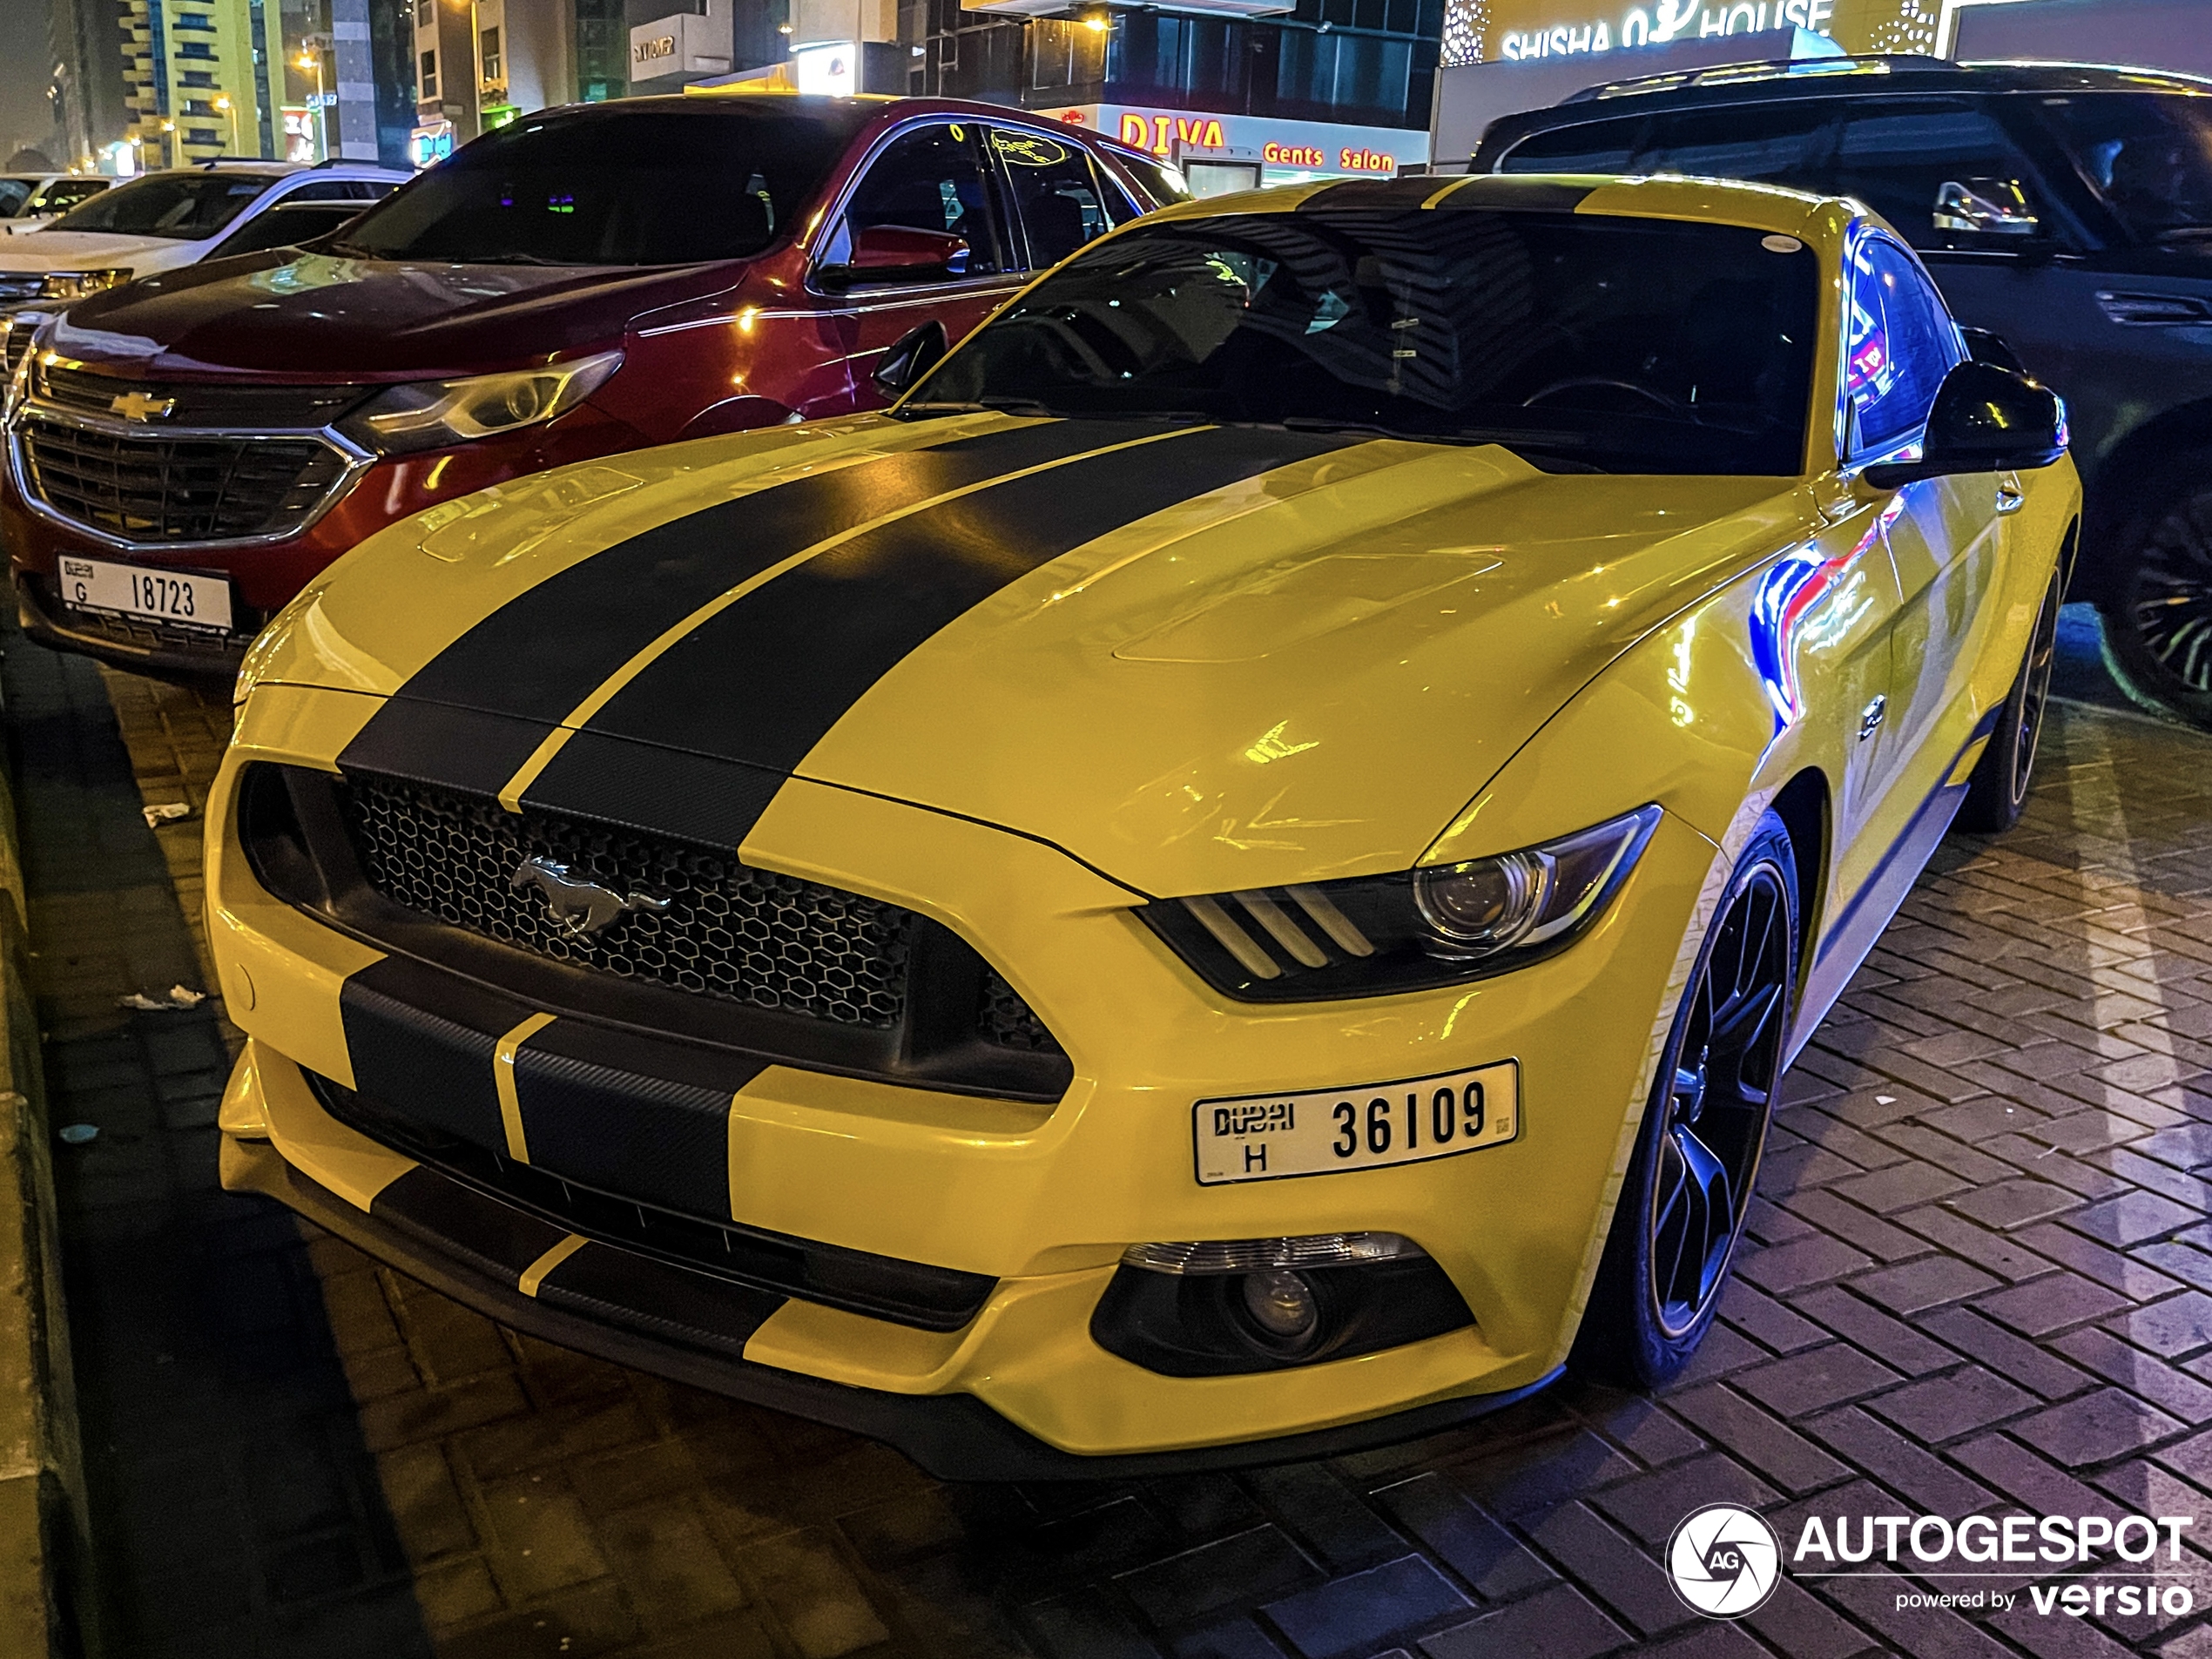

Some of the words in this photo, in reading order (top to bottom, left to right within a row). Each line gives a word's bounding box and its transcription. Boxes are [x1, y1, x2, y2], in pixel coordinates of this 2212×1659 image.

[1502, 22, 1609, 61] SHISHA
[1121, 113, 1224, 154] DIVA
[1264, 142, 1324, 166] Gents
[1340, 147, 1393, 172] Salon
[76, 582, 87, 602] G
[132, 574, 194, 616] 18723
[1332, 1081, 1484, 1157] 36109
[1244, 1143, 1267, 1173] H
